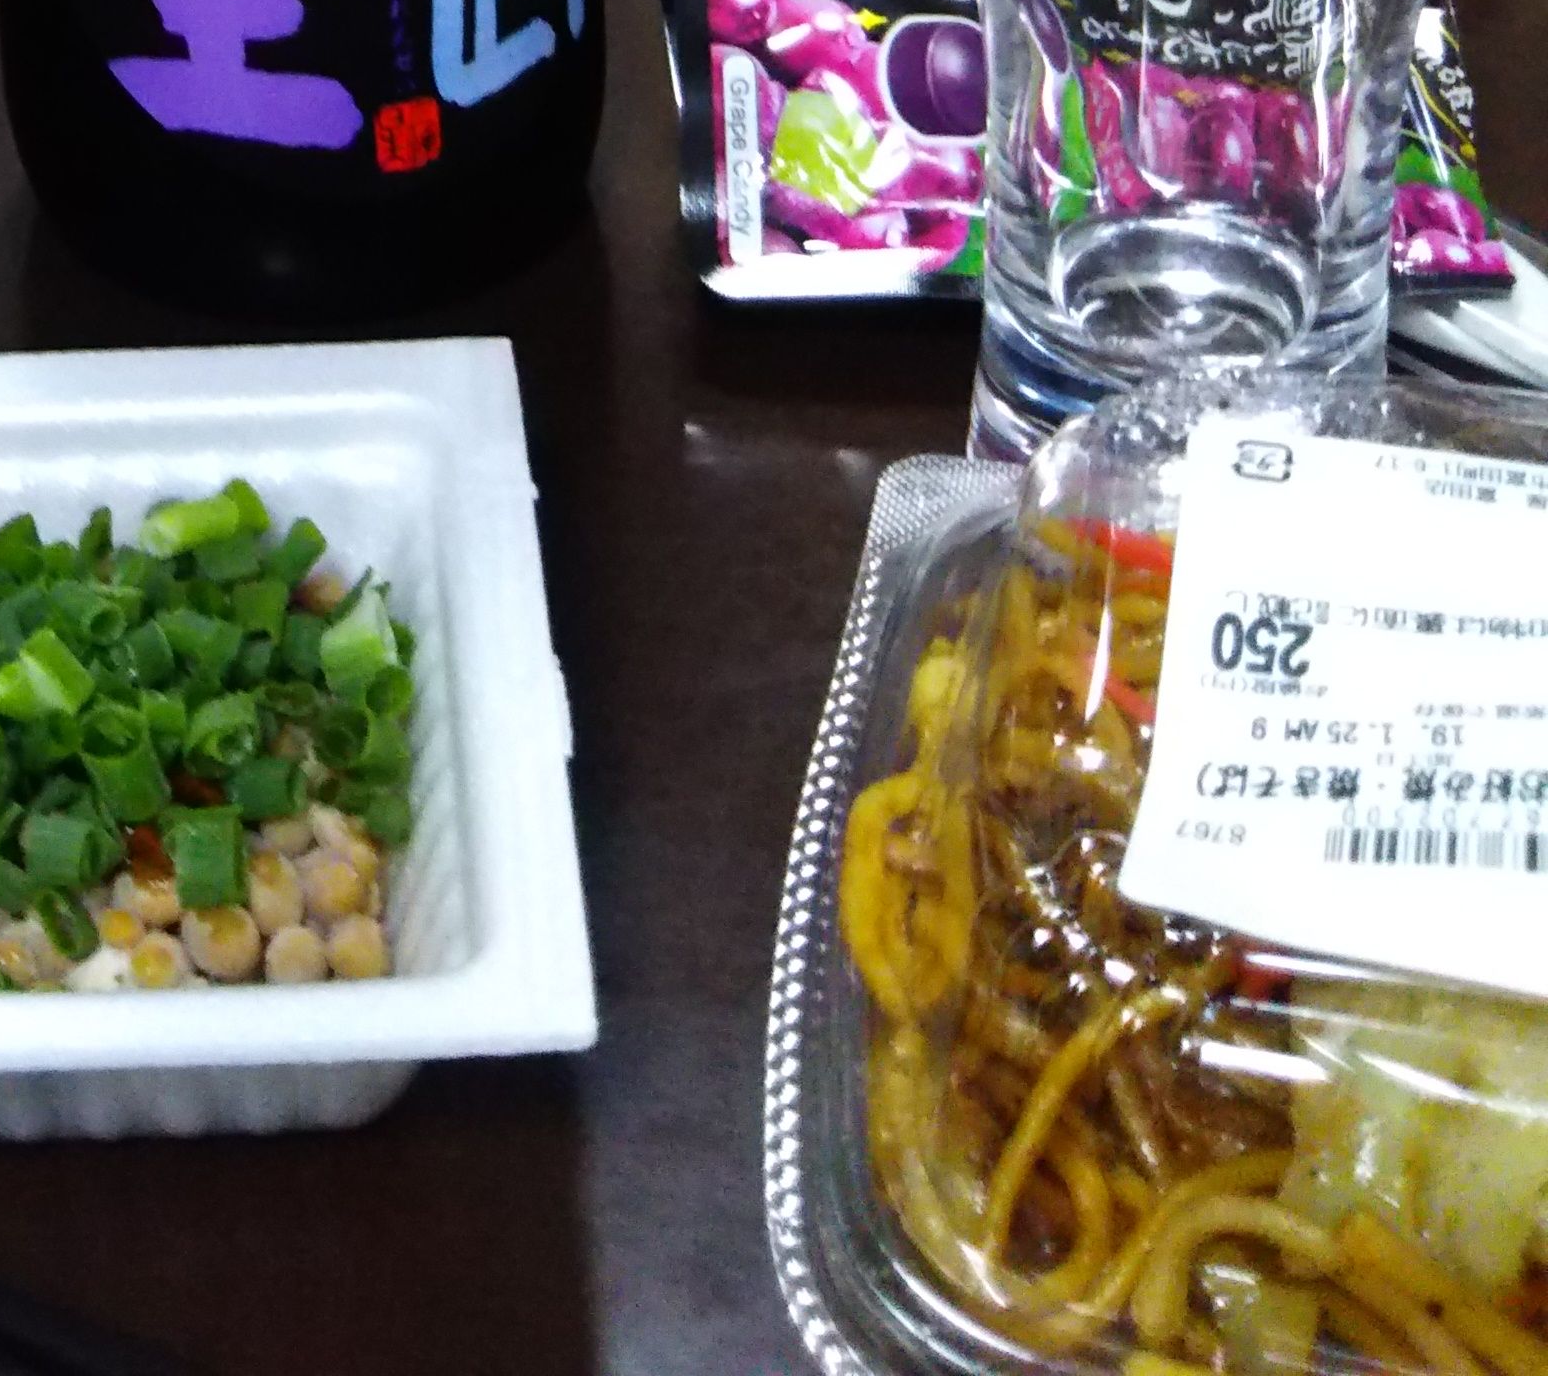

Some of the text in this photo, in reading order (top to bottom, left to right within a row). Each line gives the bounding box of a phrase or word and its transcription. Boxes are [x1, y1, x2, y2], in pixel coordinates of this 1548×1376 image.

[728, 78, 751, 152] Grape
[1211, 612, 1314, 679] 250
[1284, 718, 1320, 742] AM
